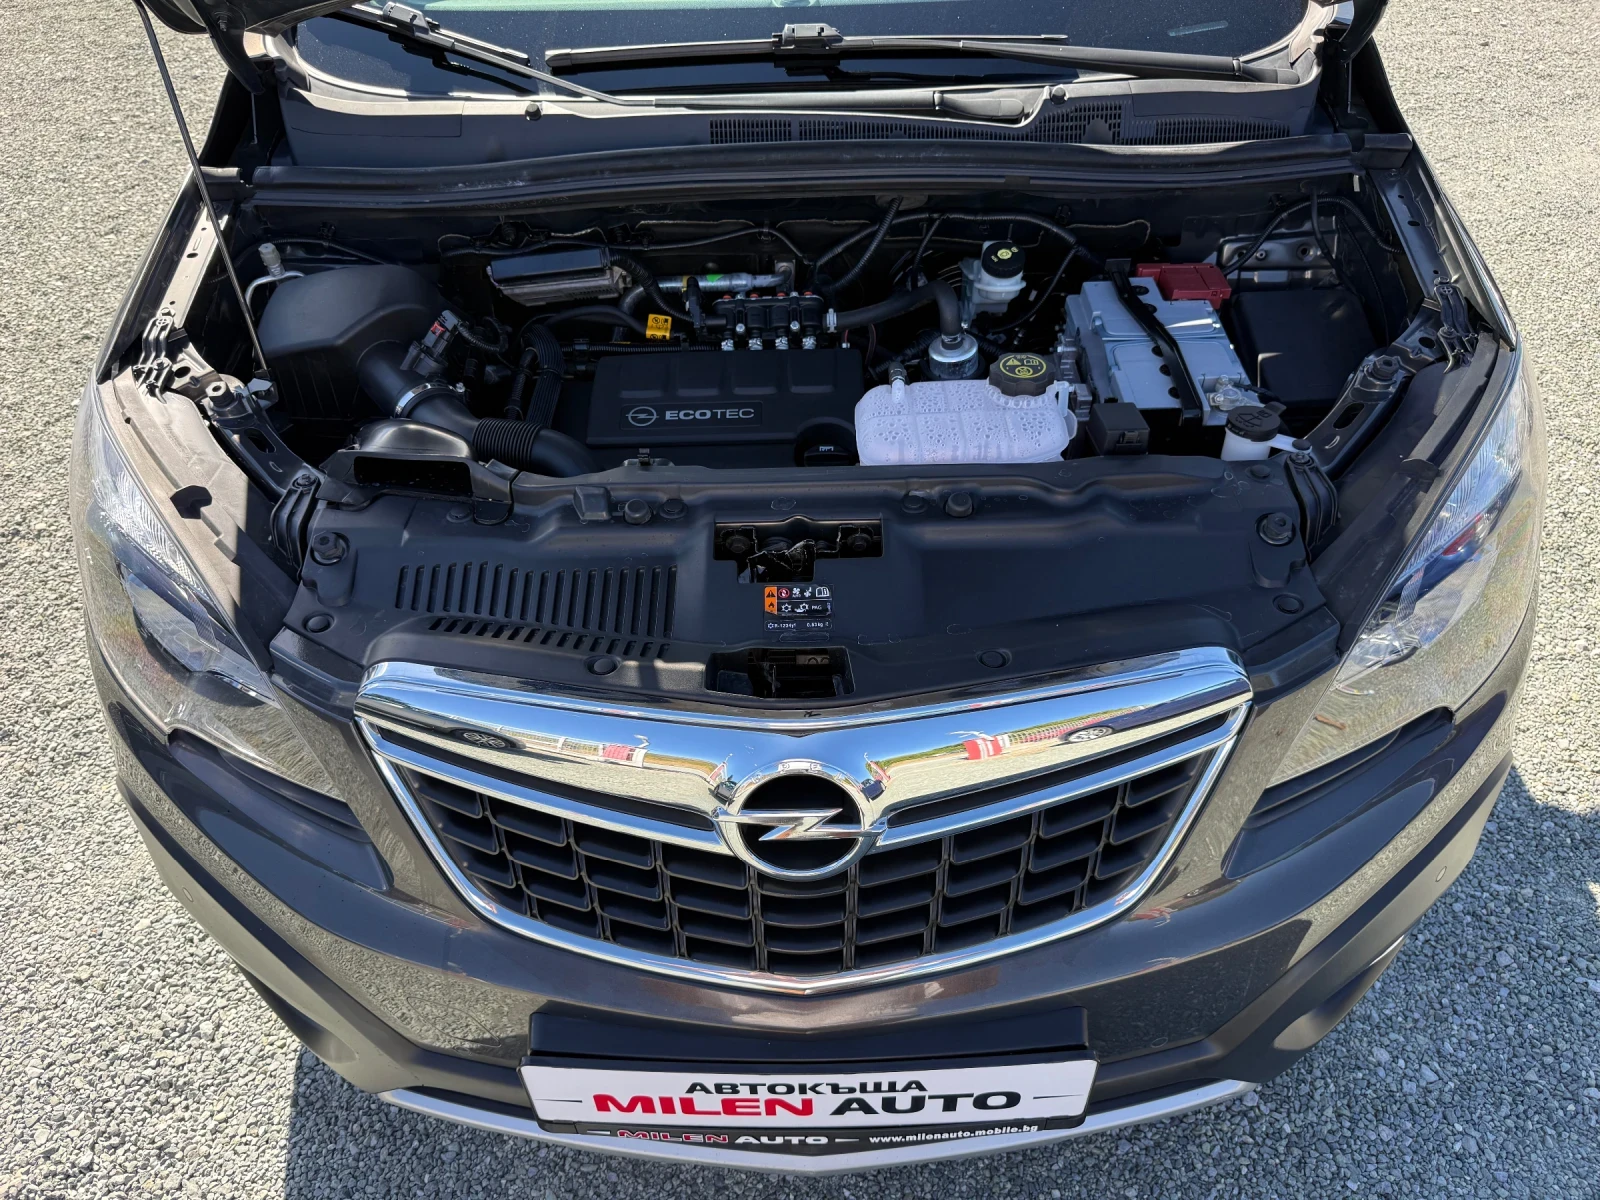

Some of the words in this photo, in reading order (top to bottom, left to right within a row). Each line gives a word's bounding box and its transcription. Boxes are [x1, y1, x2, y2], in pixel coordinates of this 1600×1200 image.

[665, 408, 755, 421] ECOTEC
[592, 1093, 813, 1117] MILEN
[829, 1091, 1022, 1116] AUTO
[617, 1129, 729, 1144] MILEN
[734, 1135, 829, 1145] AUTO
[869, 1124, 1039, 1144] www.milenauto.mobile.bg
